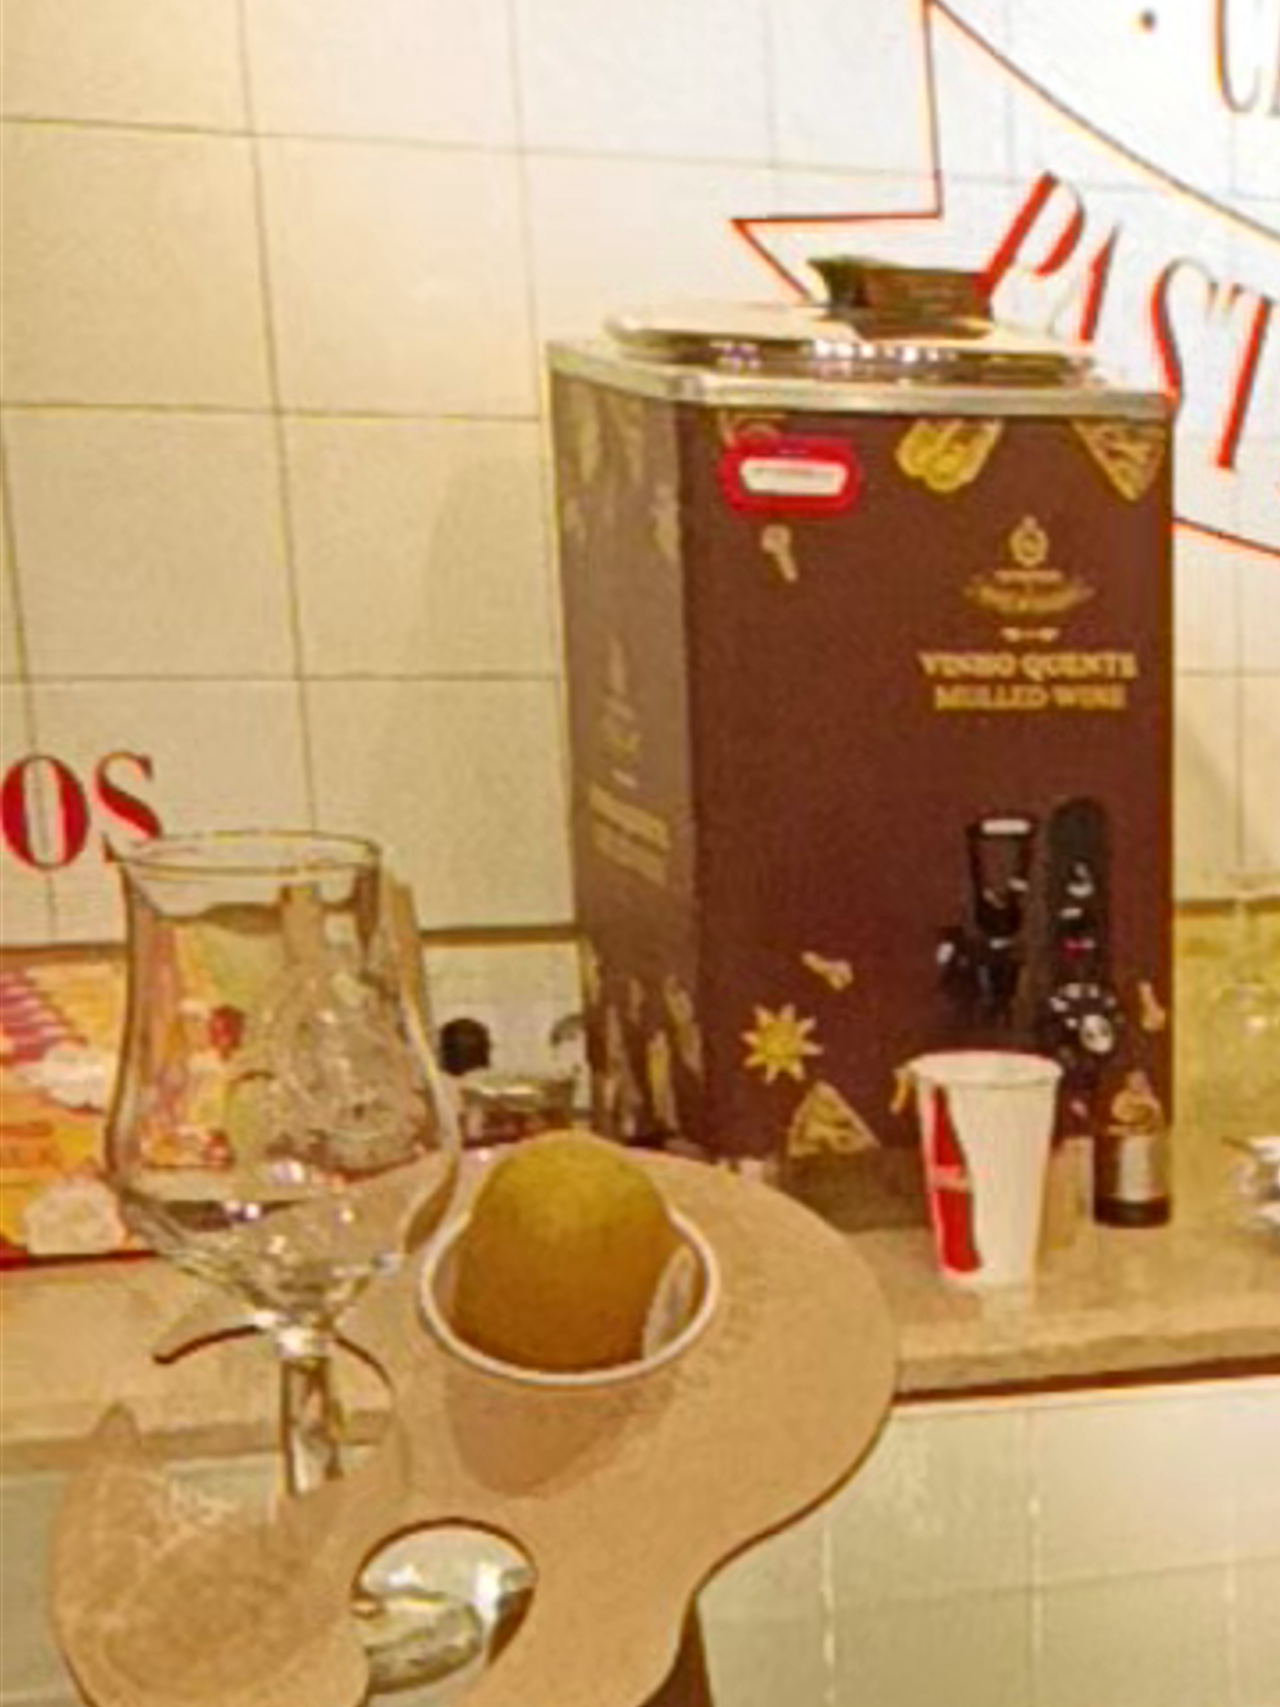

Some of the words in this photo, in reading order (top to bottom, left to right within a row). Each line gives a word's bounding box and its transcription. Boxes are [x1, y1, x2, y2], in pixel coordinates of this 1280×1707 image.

[919, 652, 1017, 678] VINHO
[1021, 652, 1139, 682] QUENTE
[935, 684, 1050, 710] MULLED
[1051, 684, 1127, 710] WINE
